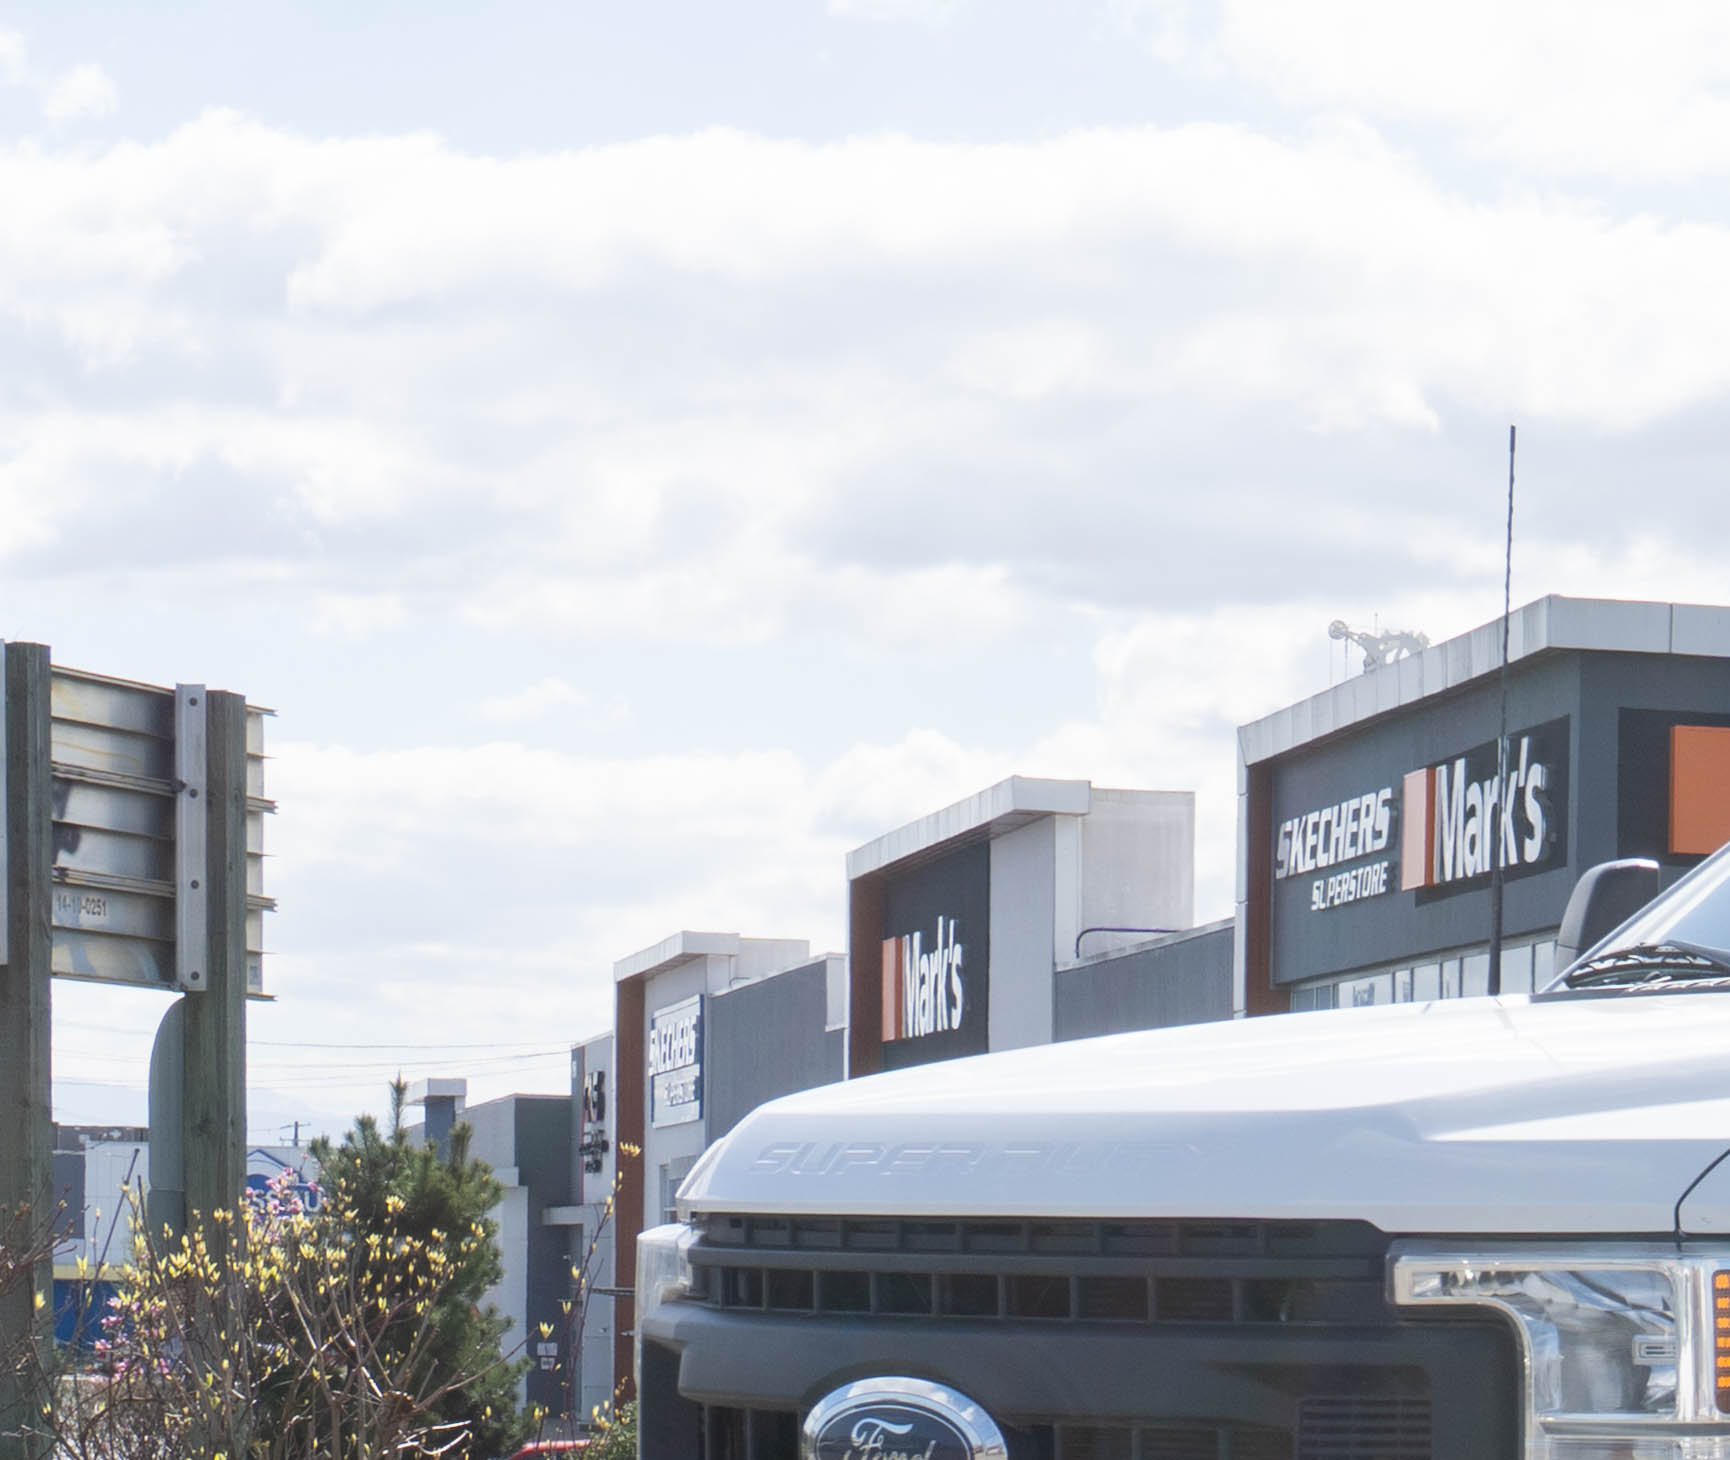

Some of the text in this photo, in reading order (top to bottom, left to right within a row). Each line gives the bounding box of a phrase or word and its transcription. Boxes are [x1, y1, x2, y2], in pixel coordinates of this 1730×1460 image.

[1276, 787, 1392, 879] SKECHERS
[1434, 736, 1546, 884] Mark's
[902, 915, 963, 1039] Mark's
[748, 1141, 984, 1176] SUPER
